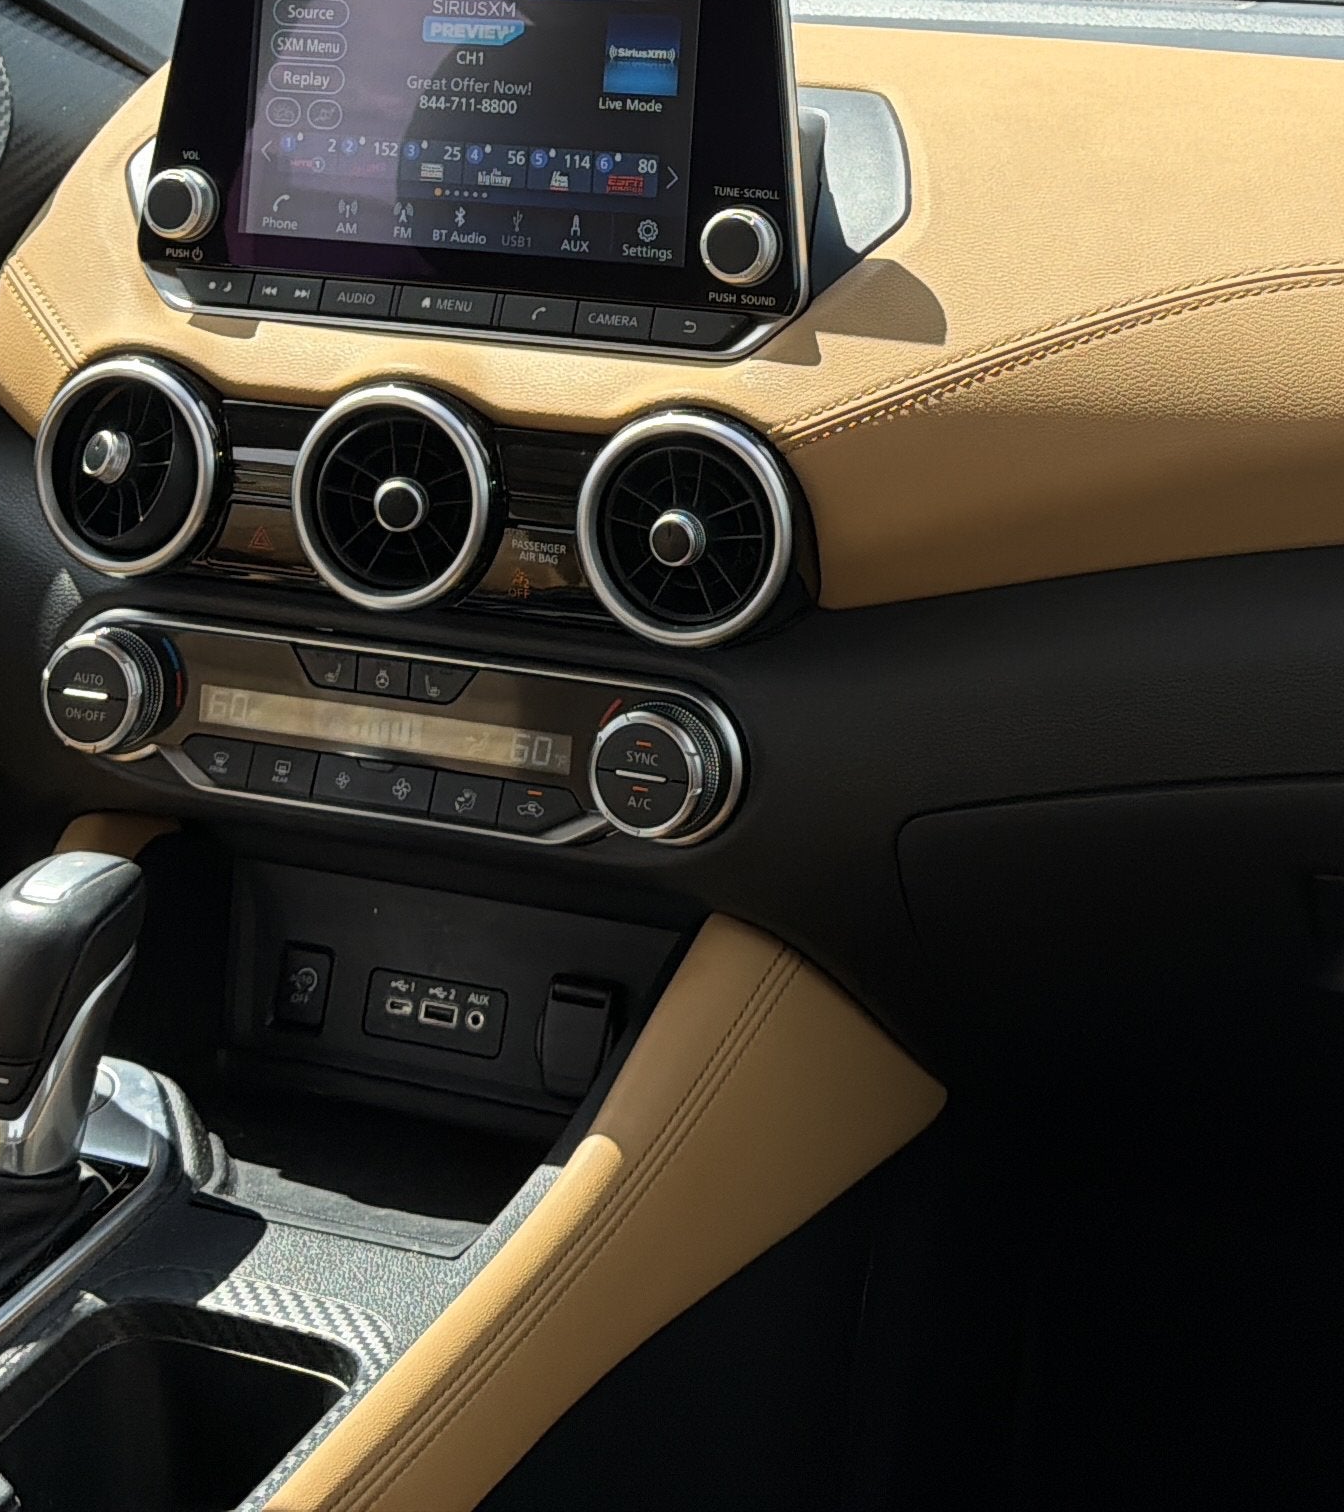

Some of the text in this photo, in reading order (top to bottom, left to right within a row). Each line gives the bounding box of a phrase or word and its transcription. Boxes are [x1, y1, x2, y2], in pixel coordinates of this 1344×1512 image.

[288, 4, 334, 20] Source
[277, 38, 339, 54] SXM Menu
[456, 51, 484, 65] CH1
[284, 72, 330, 88] Replay
[407, 76, 532, 95] Great Offer Now!
[419, 96, 517, 115] 844-711-8800
[599, 98, 662, 112] Live Mode
[328, 139, 336, 152] 2
[374, 142, 398, 157] 152
[182, 150, 200, 160] VOL
[444, 146, 461, 160] 25
[471, 149, 478, 159] 4
[508, 150, 526, 165] 56
[536, 154, 542, 164] 5
[565, 155, 591, 169] 114
[601, 158, 608, 169] 6
[638, 159, 656, 174] 80
[262, 216, 298, 230] Phone
[336, 222, 357, 233] AM
[394, 227, 412, 238] FM
[433, 229, 486, 244] BT Audio
[502, 235, 531, 248] USB1
[561, 240, 589, 252] AUX
[166, 247, 189, 258] PUSH
[623, 244, 673, 260] Settings
[337, 291, 375, 304] AUDIO
[708, 292, 776, 307] PUSH SOUND
[436, 298, 472, 312] MENU
[588, 312, 638, 328] CAMERA
[512, 539, 566, 555] PASSENGER
[519, 551, 559, 564] AIR BAG
[508, 588, 530, 599] OFF
[73, 672, 104, 686] AUTO
[210, 692, 248, 720] 60
[510, 734, 552, 766] 60
[627, 750, 658, 767] SYNC
[271, 775, 288, 784] REAR
[628, 795, 652, 810] A/C
[468, 992, 490, 1006] AUX
